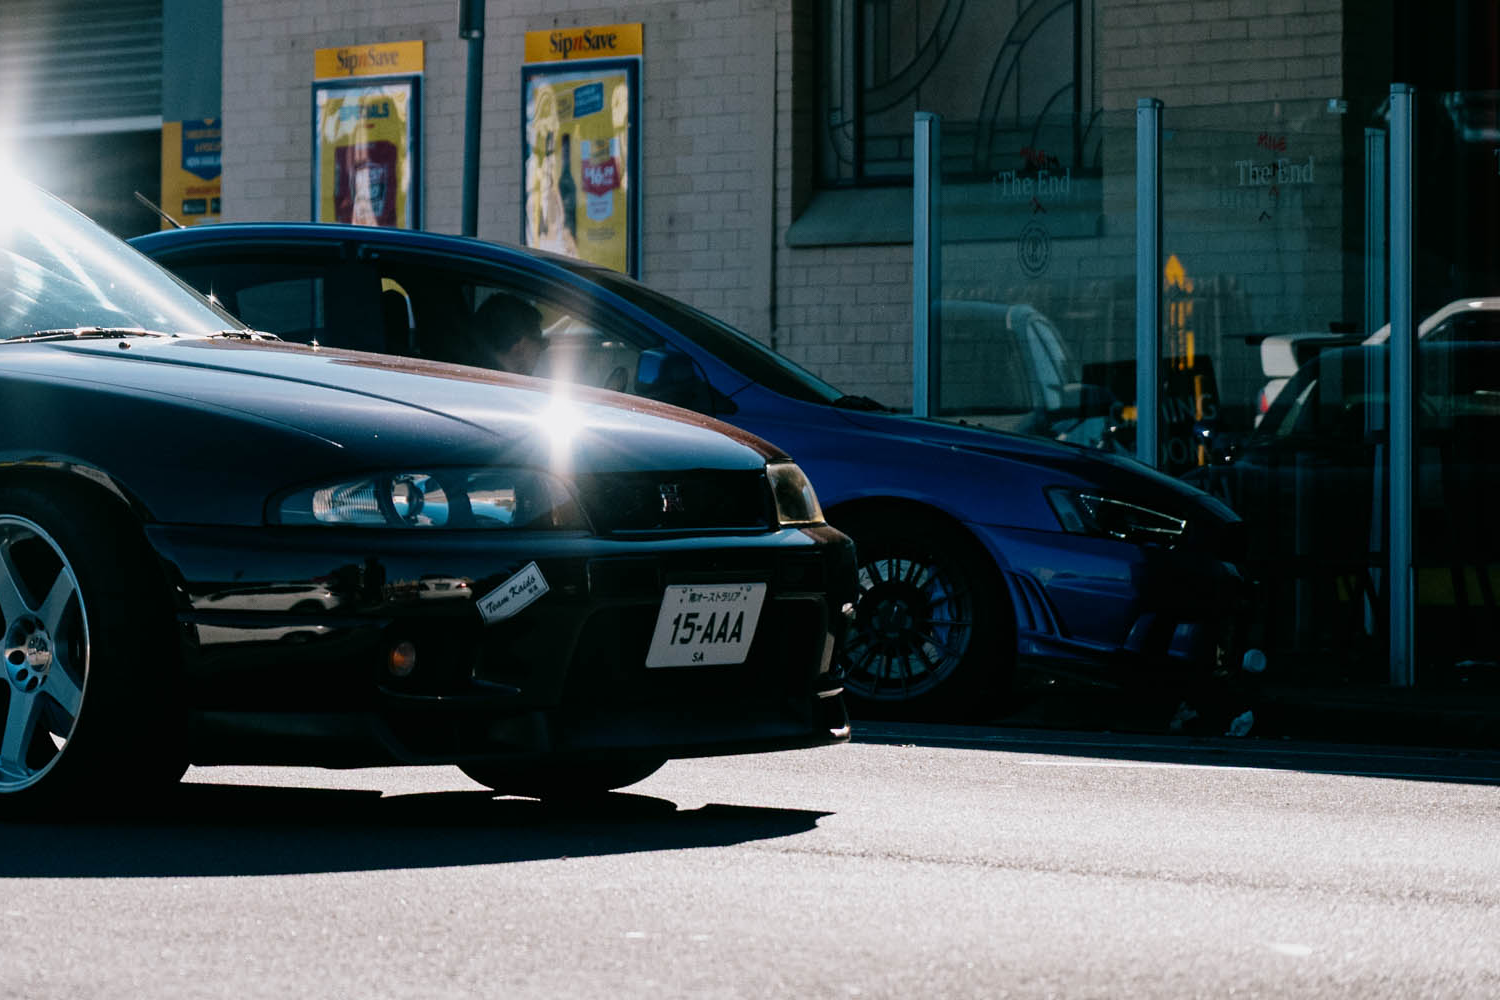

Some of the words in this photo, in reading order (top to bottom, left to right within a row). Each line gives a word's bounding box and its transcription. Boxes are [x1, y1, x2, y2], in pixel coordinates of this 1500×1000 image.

[1235, 160, 1271, 186] The
[1277, 155, 1316, 184] End
[692, 652, 705, 663] SA
